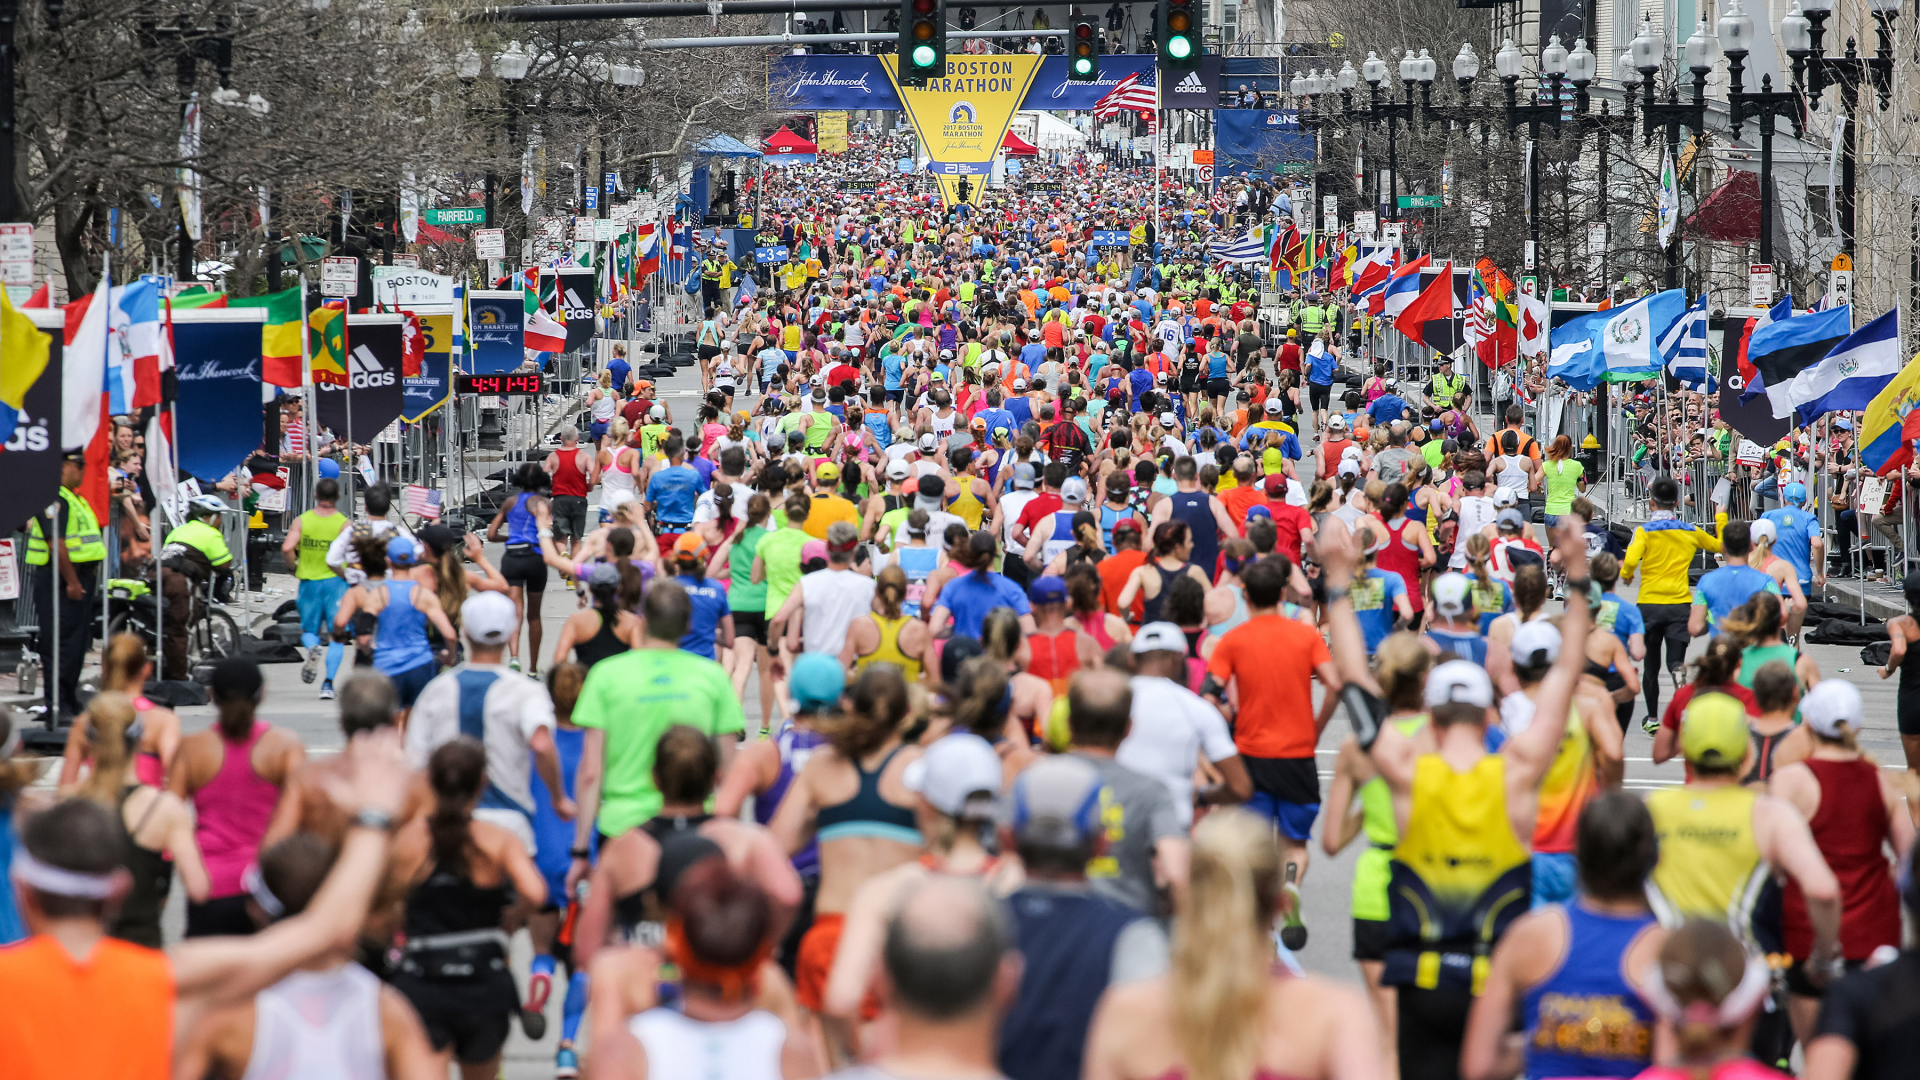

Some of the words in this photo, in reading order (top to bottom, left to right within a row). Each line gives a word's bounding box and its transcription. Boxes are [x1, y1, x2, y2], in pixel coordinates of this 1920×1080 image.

[947, 62, 1012, 75] BOSTON
[785, 70, 821, 98] John
[820, 69, 872, 94] Hancock
[1174, 84, 1207, 93] adidas
[1410, 197, 1424, 207] RING
[437, 210, 474, 222] FAIRFIELD
[1106, 232, 1116, 245] 3
[766, 248, 775, 261] 3
[387, 276, 439, 288] BOSTON
[1164, 328, 1175, 341] 16
